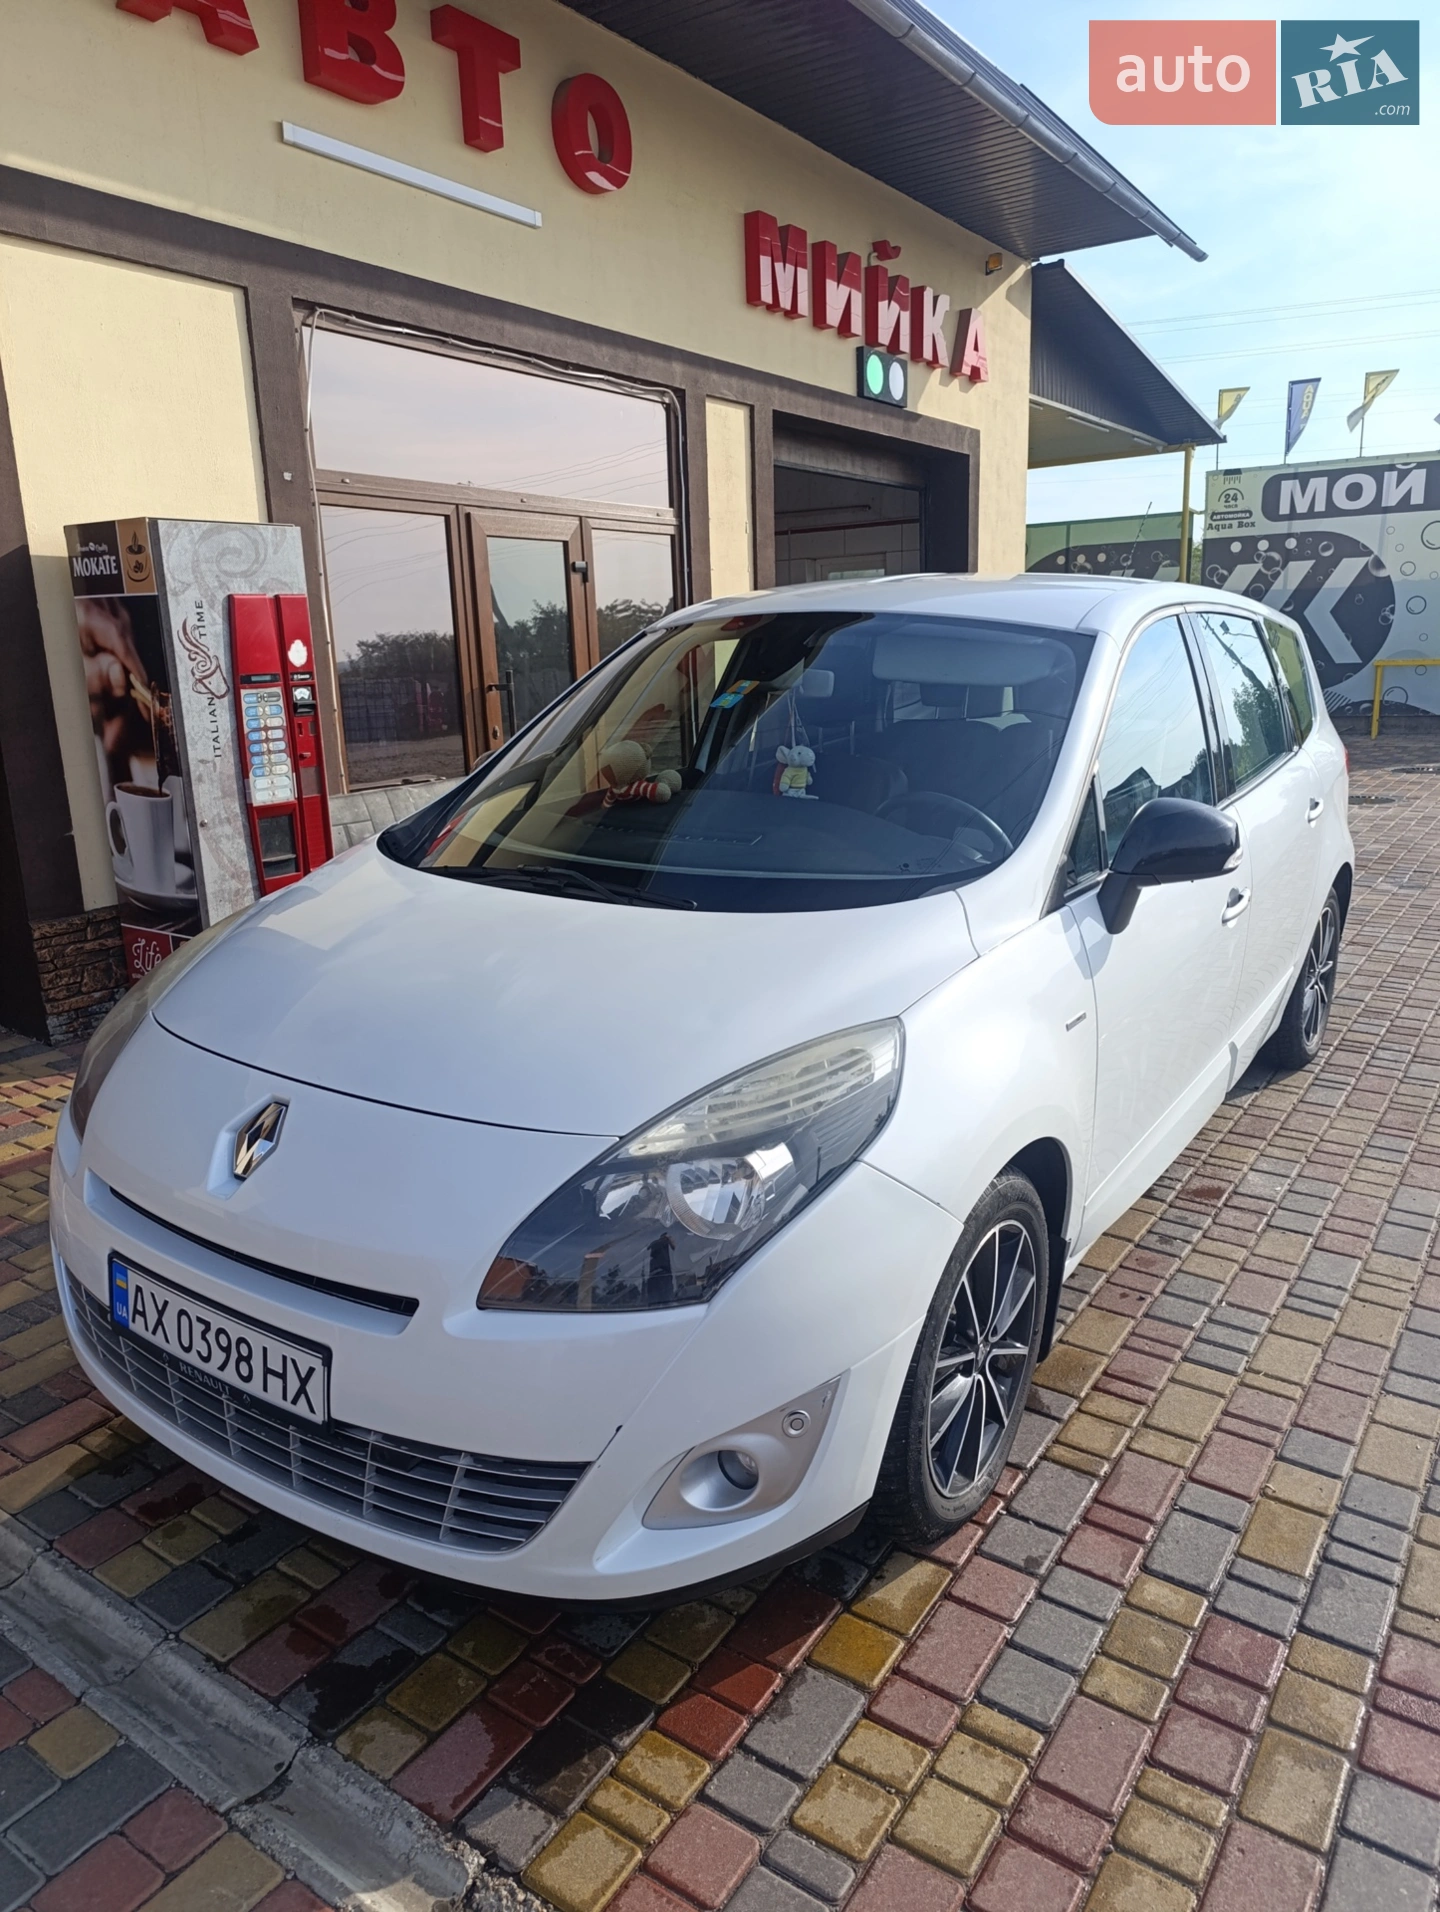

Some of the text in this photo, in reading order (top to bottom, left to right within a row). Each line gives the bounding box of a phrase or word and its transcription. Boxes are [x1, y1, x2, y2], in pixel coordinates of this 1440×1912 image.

[744, 210, 989, 383] МИЙКА
[1224, 493, 1238, 503] 24
[1279, 463, 1427, 515] МОЙ
[1207, 522, 1233, 531] Aqua
[72, 554, 118, 577] MOKATE
[195, 600, 222, 758] ITALIAN TIME
[116, 1302, 128, 1319] UA
[132, 1284, 317, 1415] AX 0398 HX
[179, 1361, 230, 1395] RENAULT
